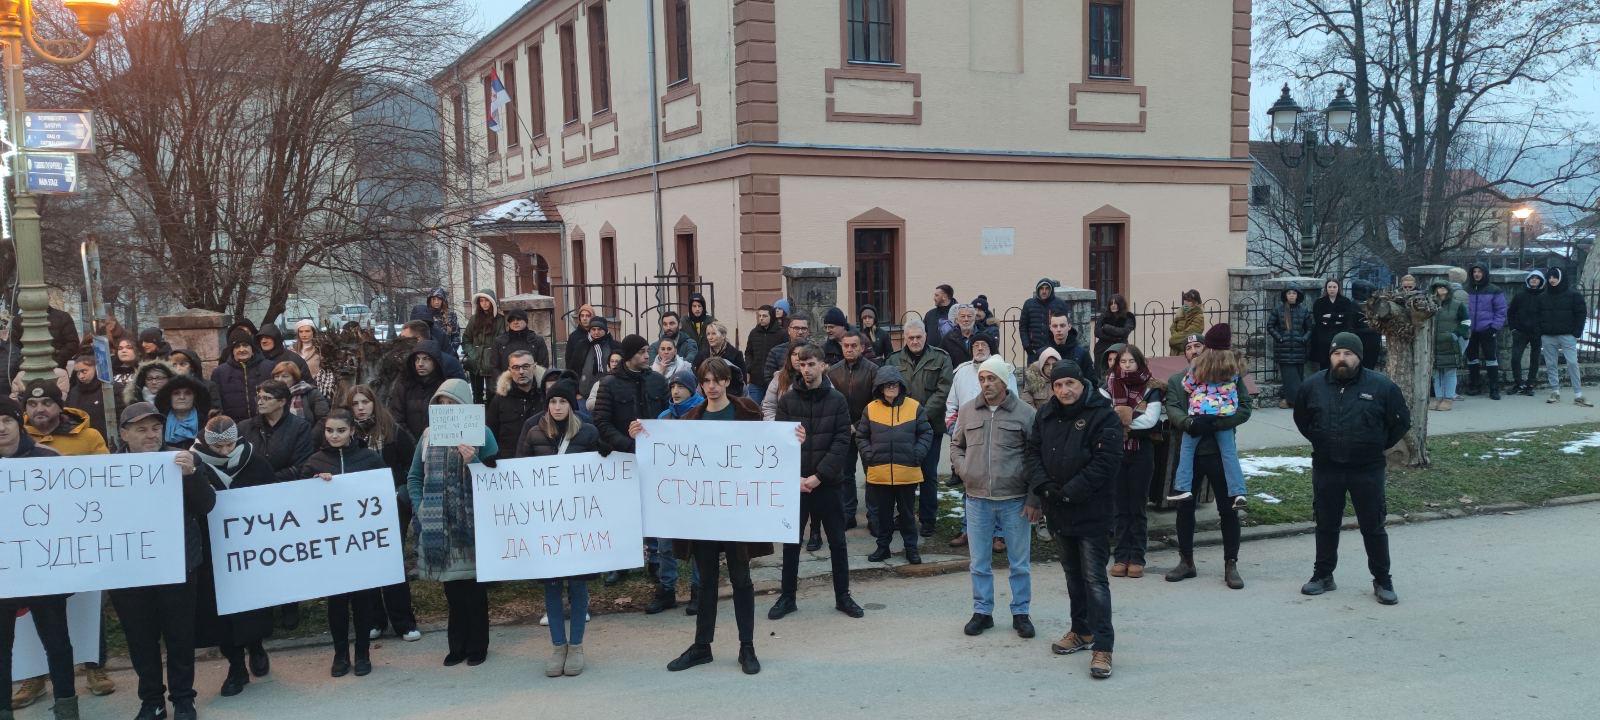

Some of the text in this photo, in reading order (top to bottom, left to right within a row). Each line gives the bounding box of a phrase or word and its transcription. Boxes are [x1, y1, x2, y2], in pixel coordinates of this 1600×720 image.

[653, 443, 779, 469] ГУЧА ЈЕ УЗ
[0, 463, 165, 492] НЗИОНЕРИ
[476, 460, 633, 491] МАМА МЕ НИЈЕ
[657, 478, 785, 508] СТУДЕНТЕ
[23, 500, 103, 527] СУ УЗ
[223, 496, 383, 539] ГУЧА ЈЕ УЗ
[493, 495, 603, 526] НАУЧИЛА
[227, 527, 390, 573] ПРОСВЕТАРЕ
[502, 538, 534, 559] ДА
